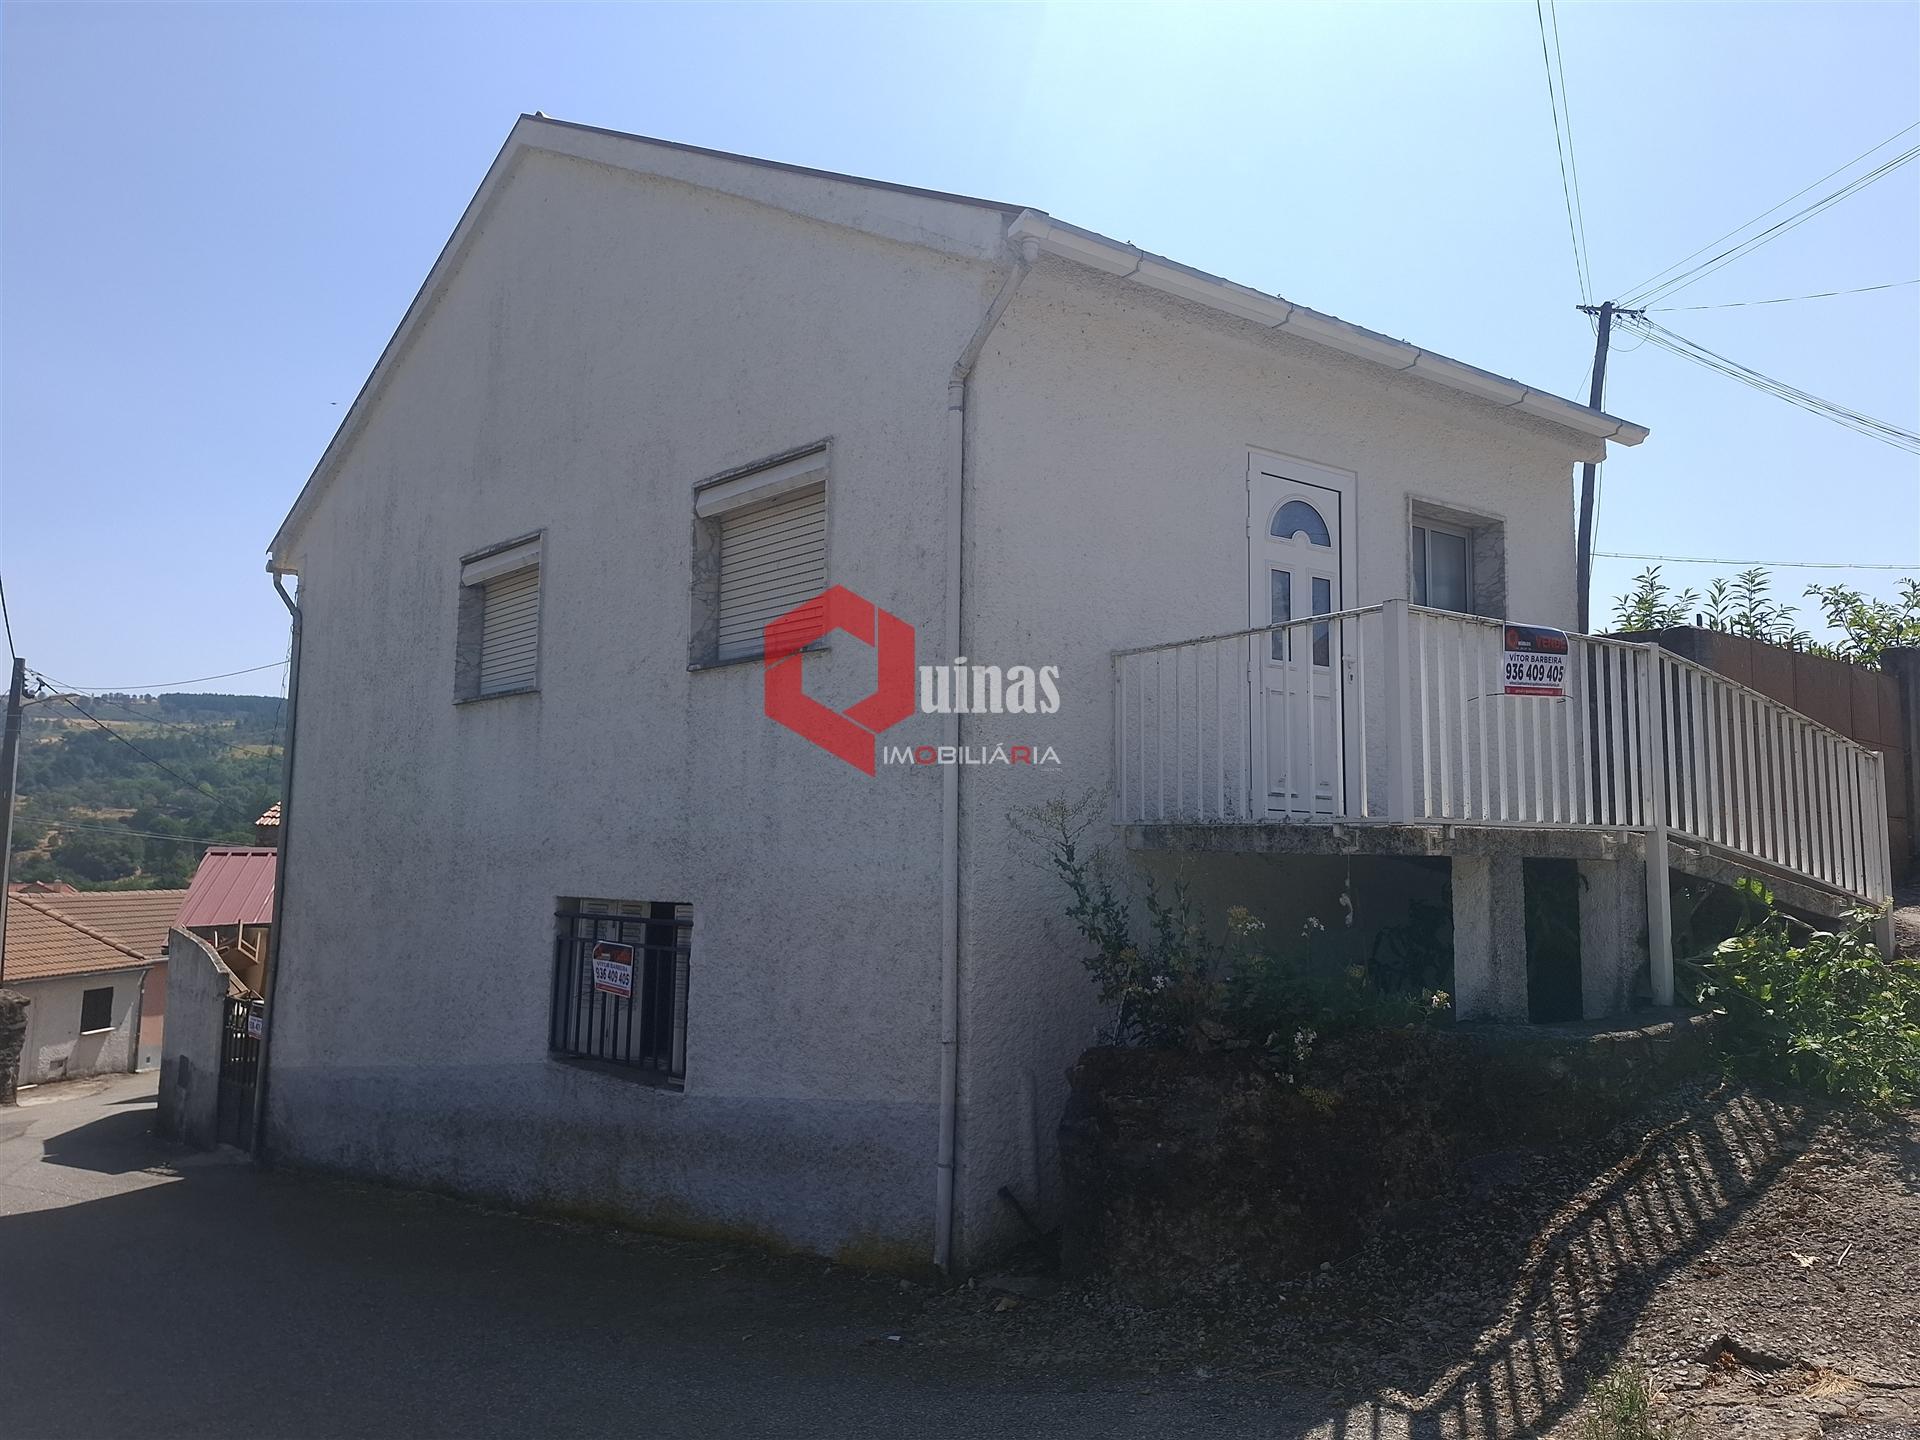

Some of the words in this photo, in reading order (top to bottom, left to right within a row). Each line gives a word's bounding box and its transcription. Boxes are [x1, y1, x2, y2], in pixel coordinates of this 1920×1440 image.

[1530, 655, 1563, 665] BARBEIRA
[1506, 663, 1524, 681] 936
[1526, 664, 1545, 682] 409
[1547, 665, 1564, 683] 405
[595, 967, 607, 980] 936
[607, 969, 619, 983] 409
